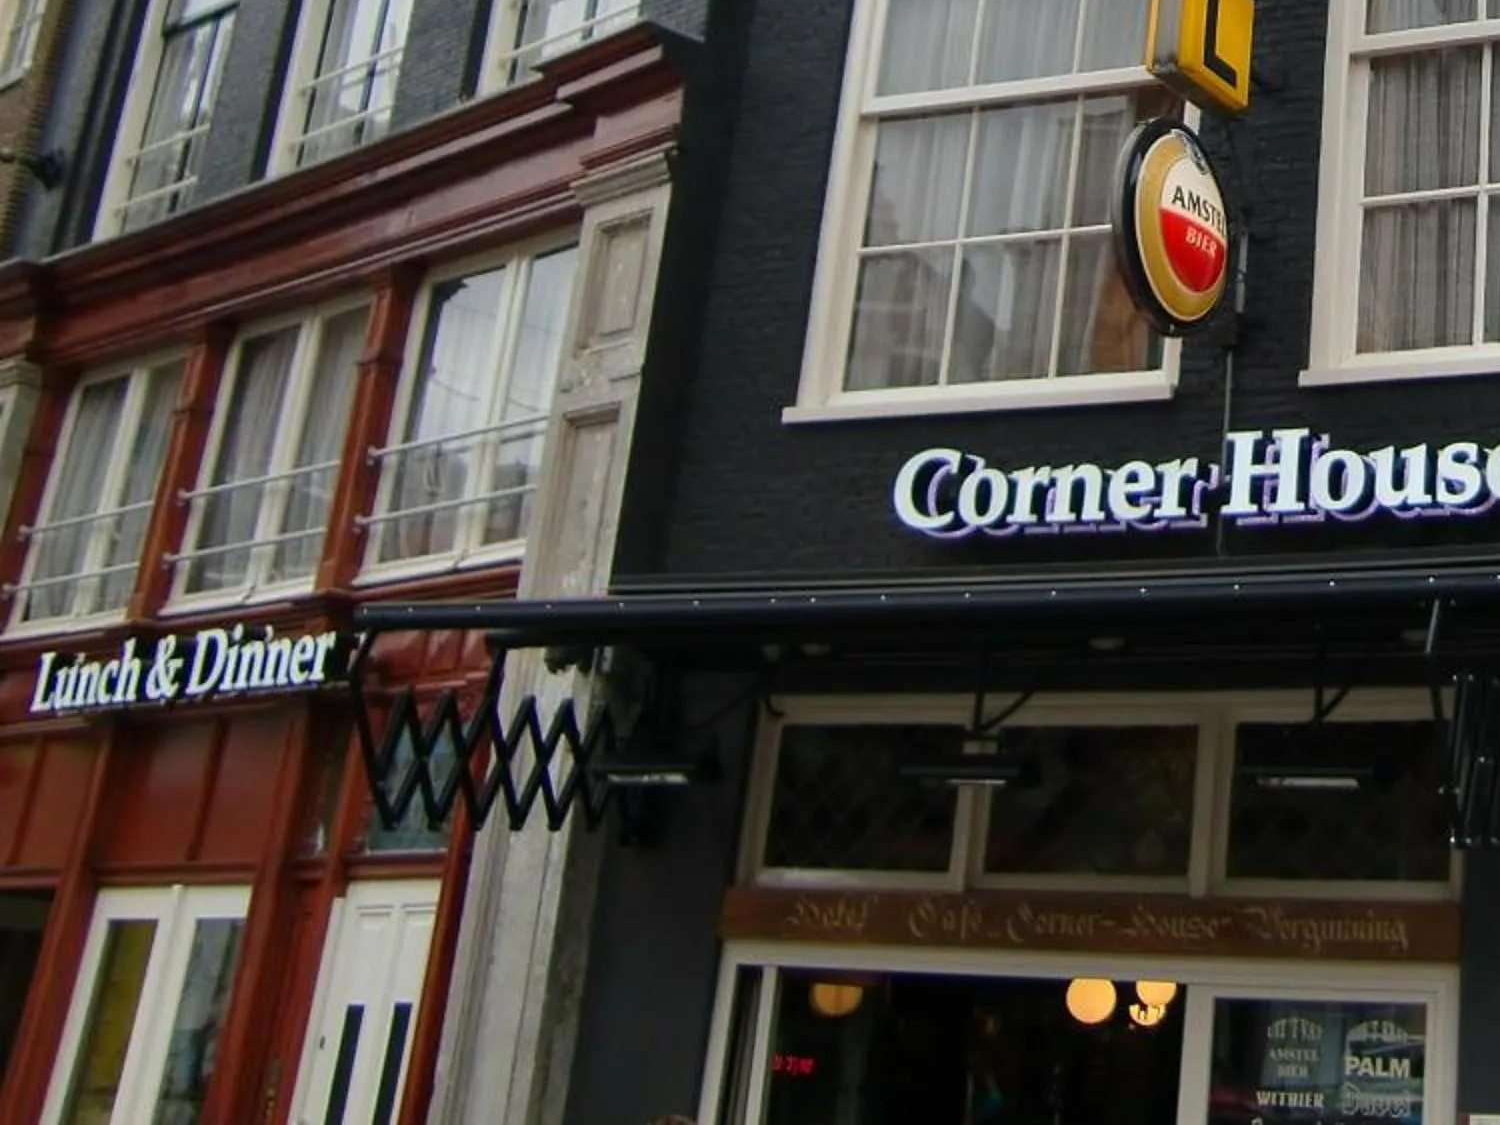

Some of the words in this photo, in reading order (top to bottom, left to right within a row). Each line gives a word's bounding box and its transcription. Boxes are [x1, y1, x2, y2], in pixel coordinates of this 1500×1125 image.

[1185, 226, 1217, 258] BIER
[893, 447, 1203, 533] Corner
[30, 636, 142, 713] Lunch
[145, 634, 184, 700] &
[184, 624, 337, 695] Dinner
[1344, 1056, 1411, 1078] PALM
[1256, 1090, 1325, 1108] WITBIER
